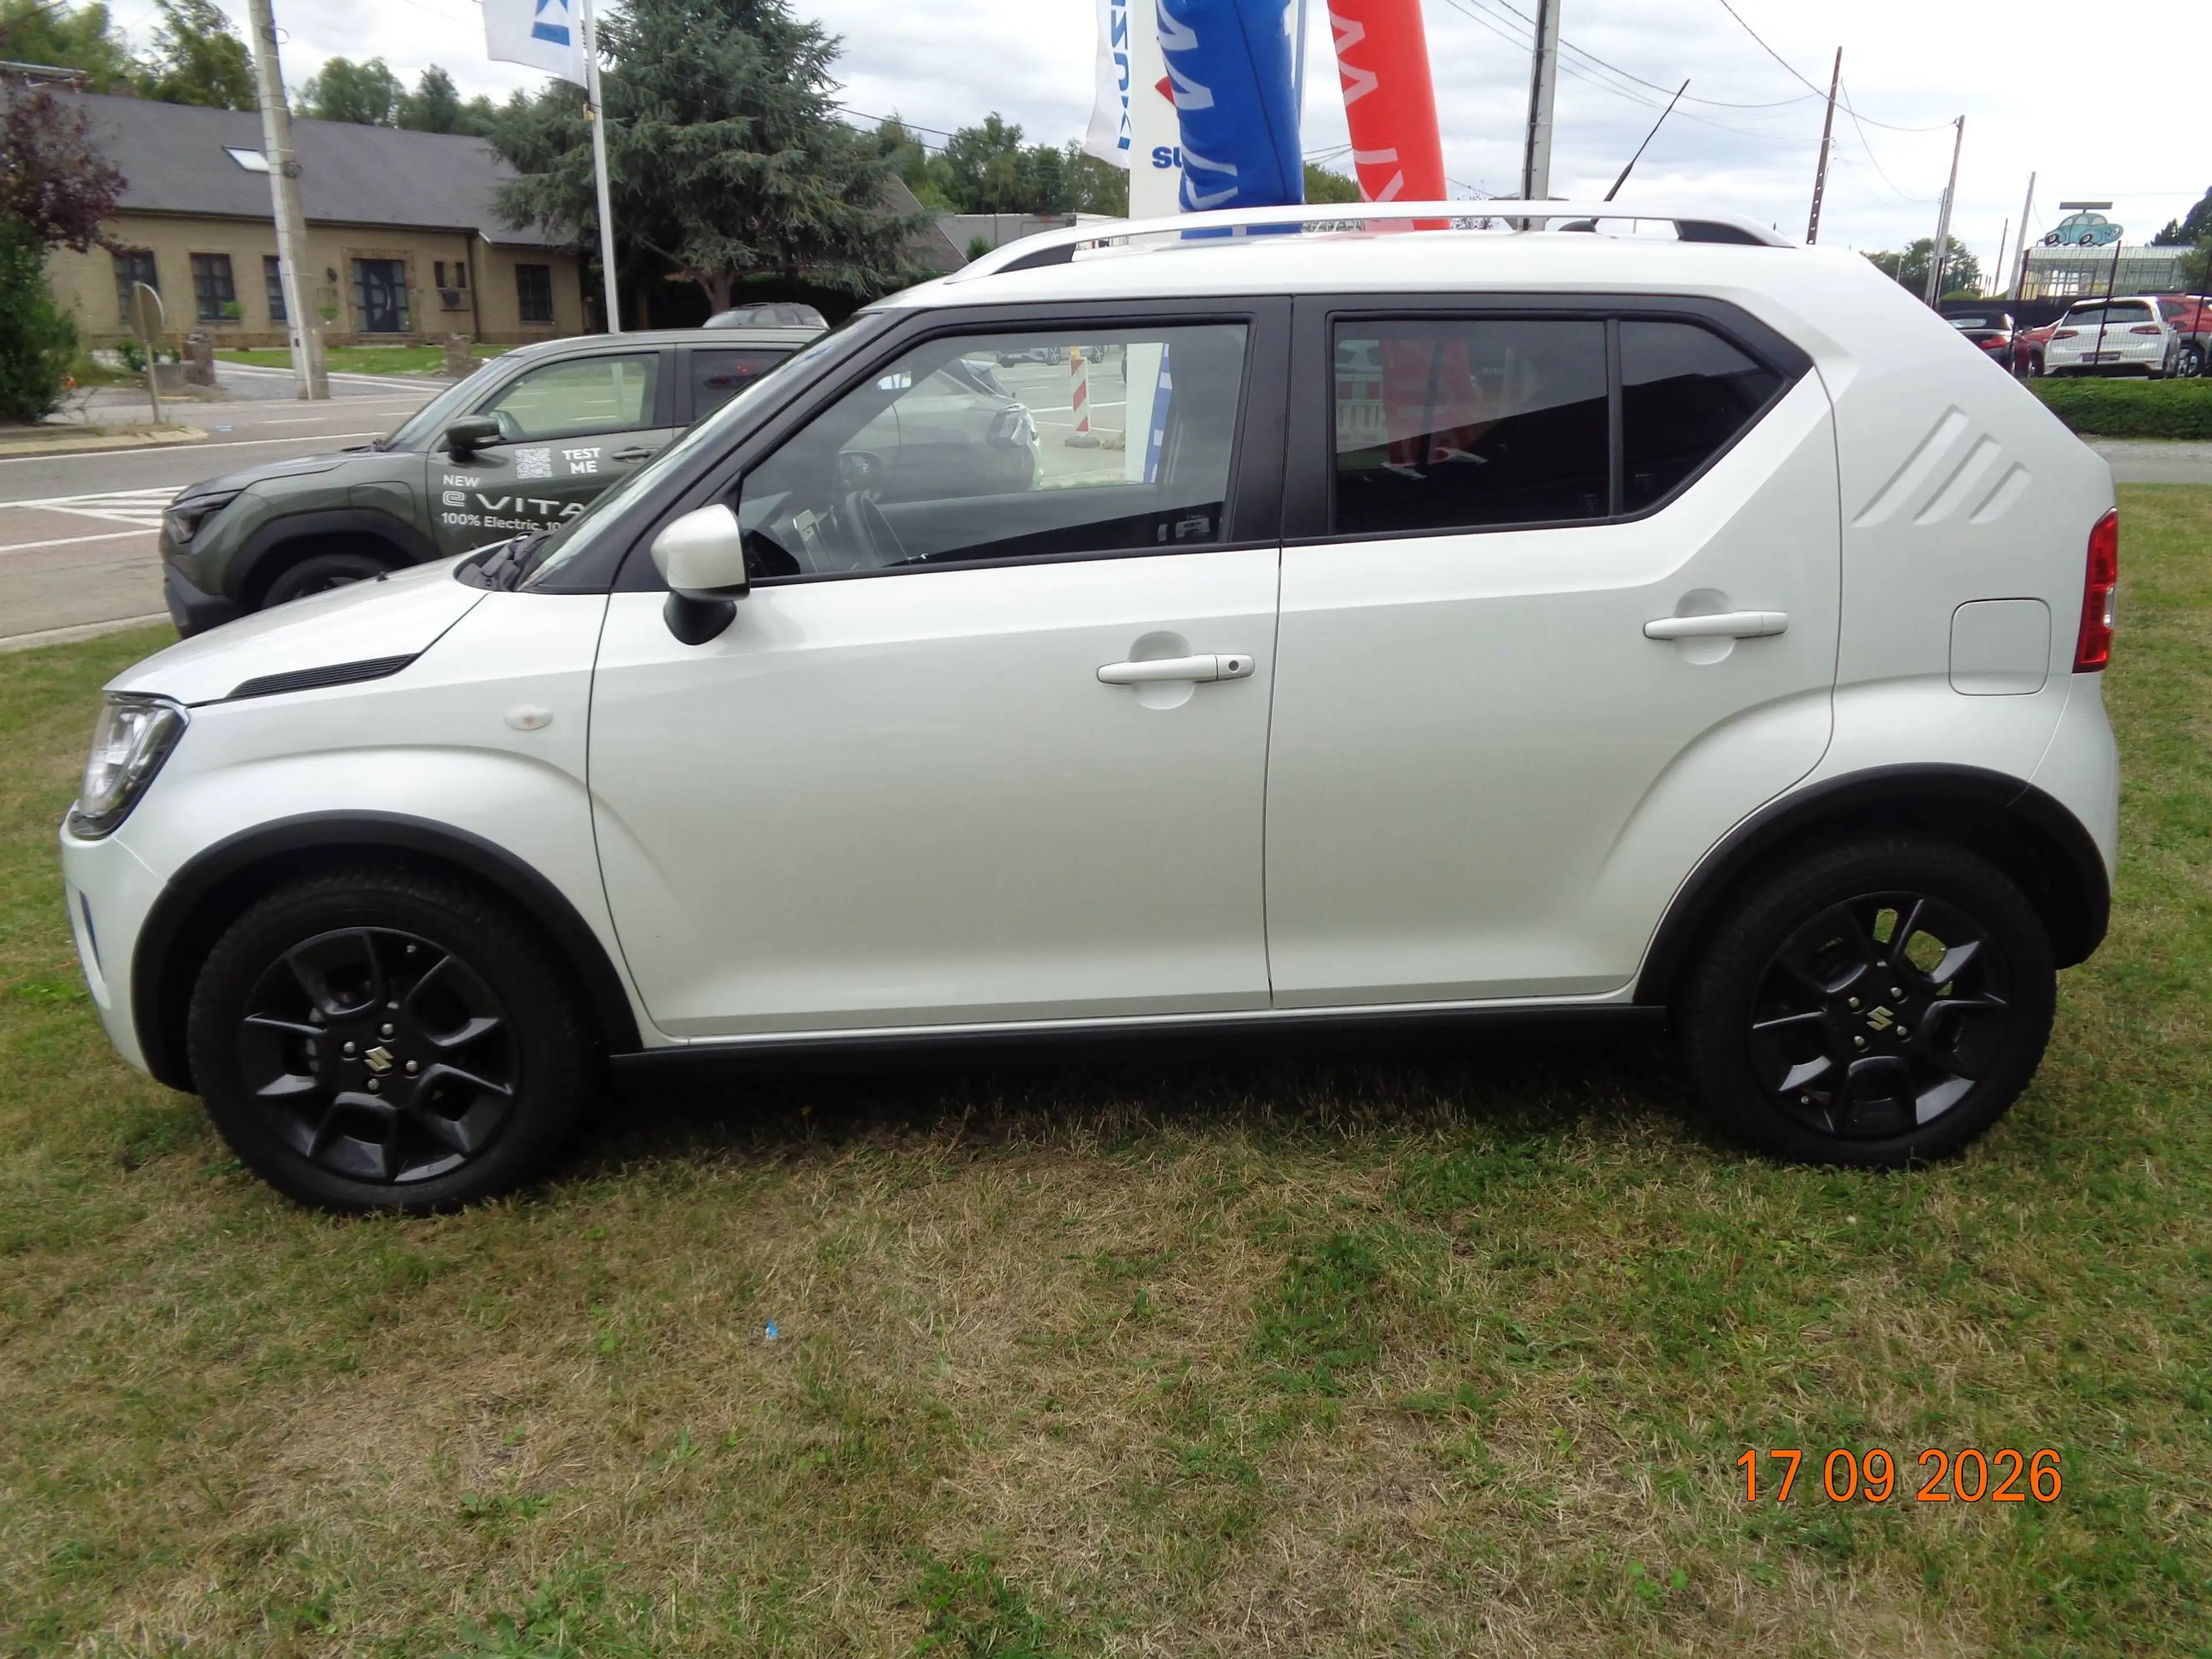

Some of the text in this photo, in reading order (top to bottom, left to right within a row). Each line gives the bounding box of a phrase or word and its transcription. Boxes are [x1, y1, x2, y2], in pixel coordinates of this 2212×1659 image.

[562, 448, 601, 460] TEST
[570, 461, 598, 474] ME
[443, 474, 480, 487] NEW
[441, 512, 481, 527] 100%
